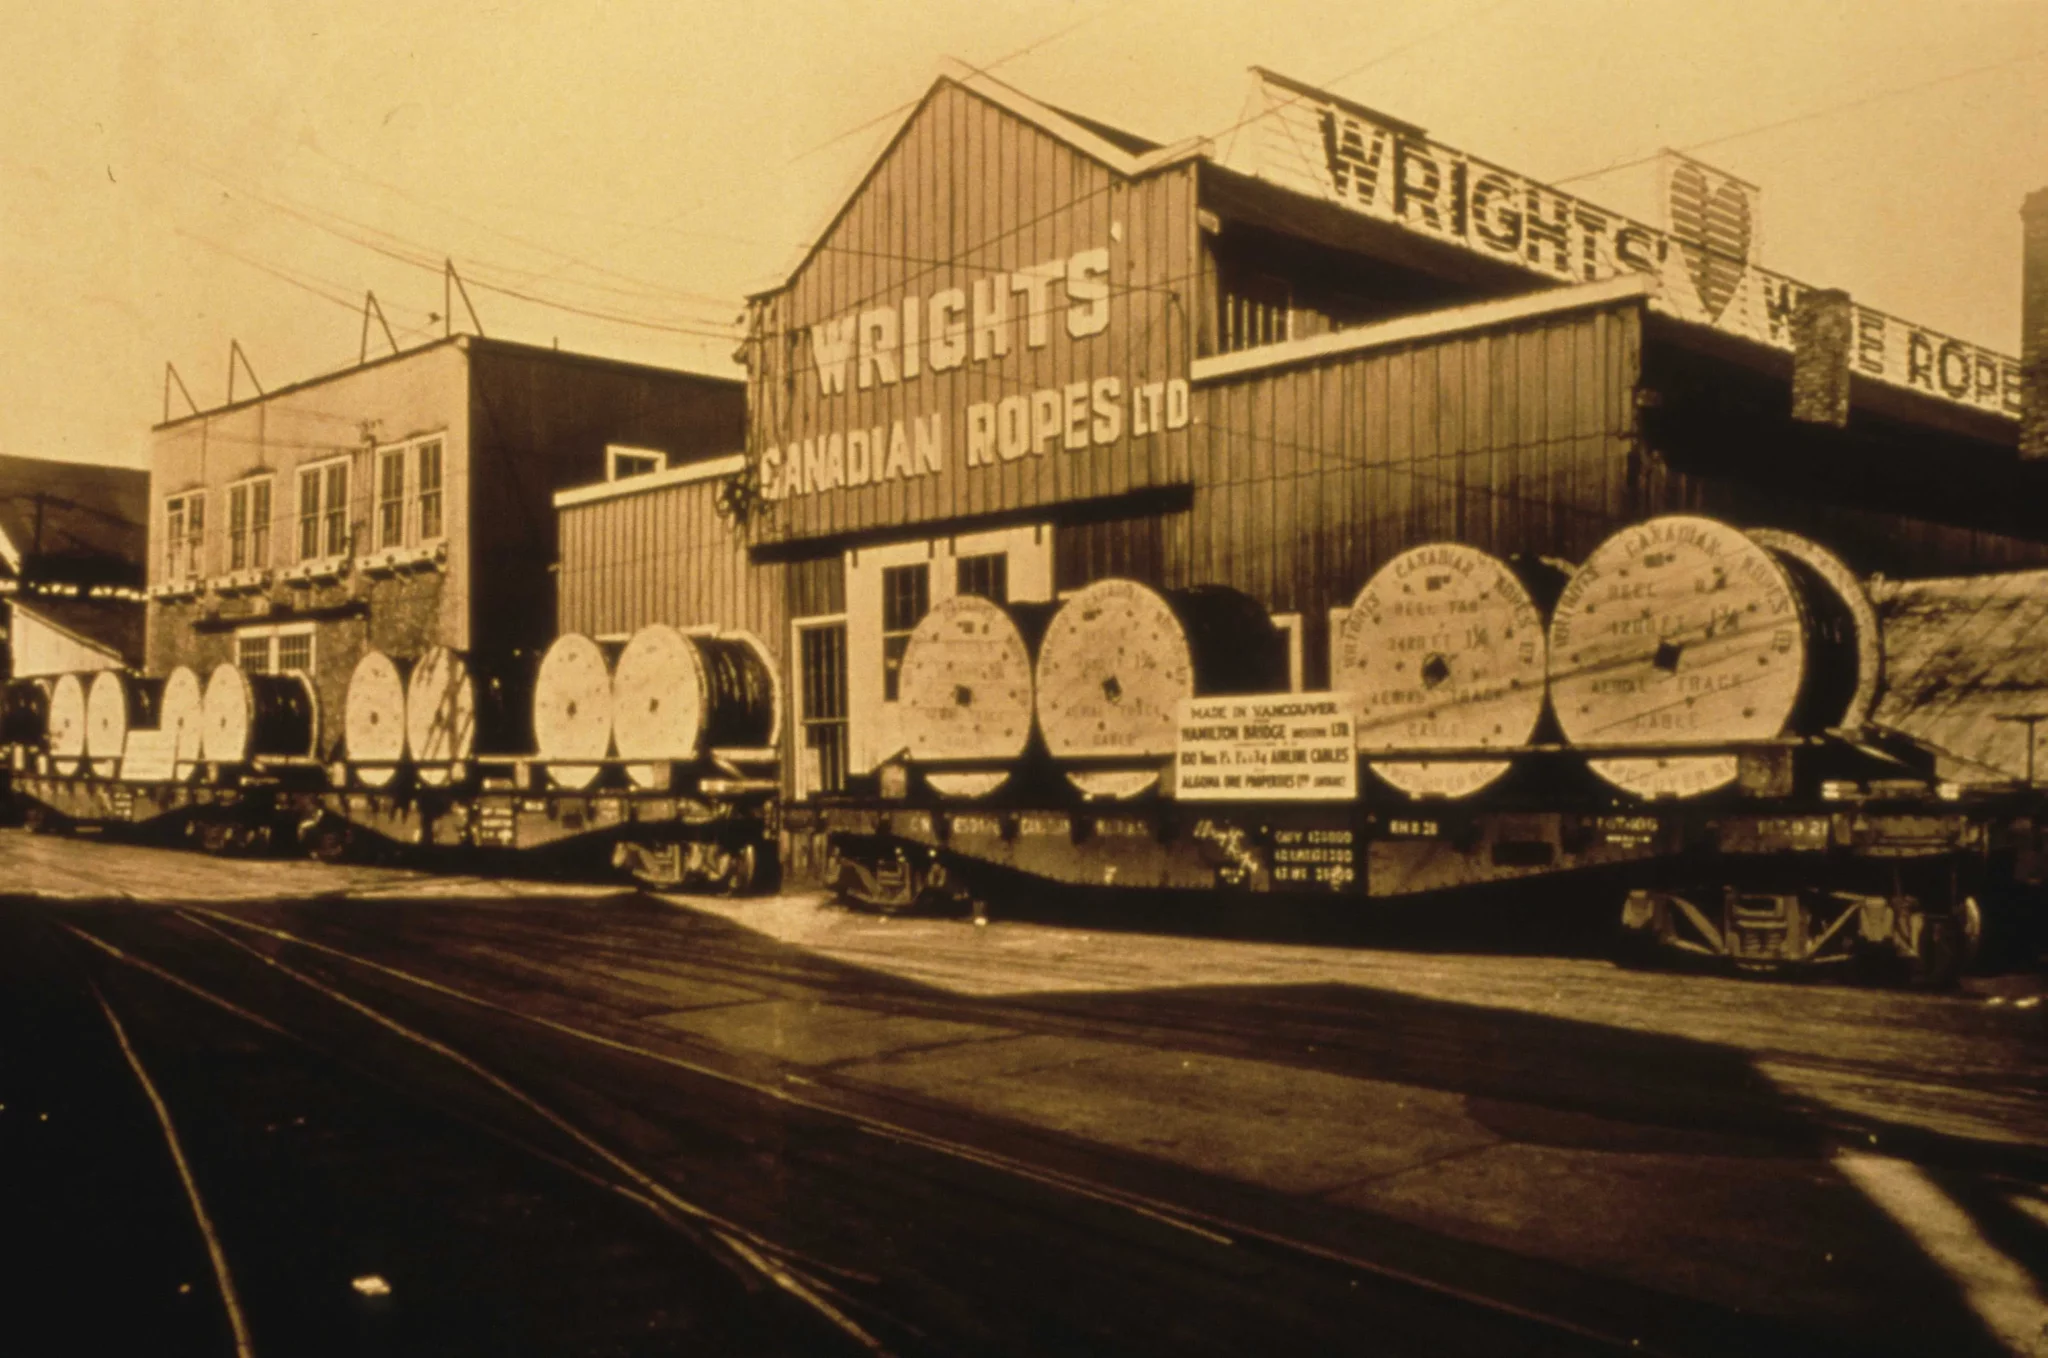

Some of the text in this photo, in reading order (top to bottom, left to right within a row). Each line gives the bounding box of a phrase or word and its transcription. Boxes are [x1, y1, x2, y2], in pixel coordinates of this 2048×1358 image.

[1763, 277, 1884, 373] WE
[760, 413, 942, 500] CANADIAN
[967, 376, 1121, 468] ROPES
[1181, 726, 1239, 741] HAMILTON
[1243, 723, 1286, 740] BRIDGE
[1190, 702, 1338, 719] MADE IN VANCOUVER
